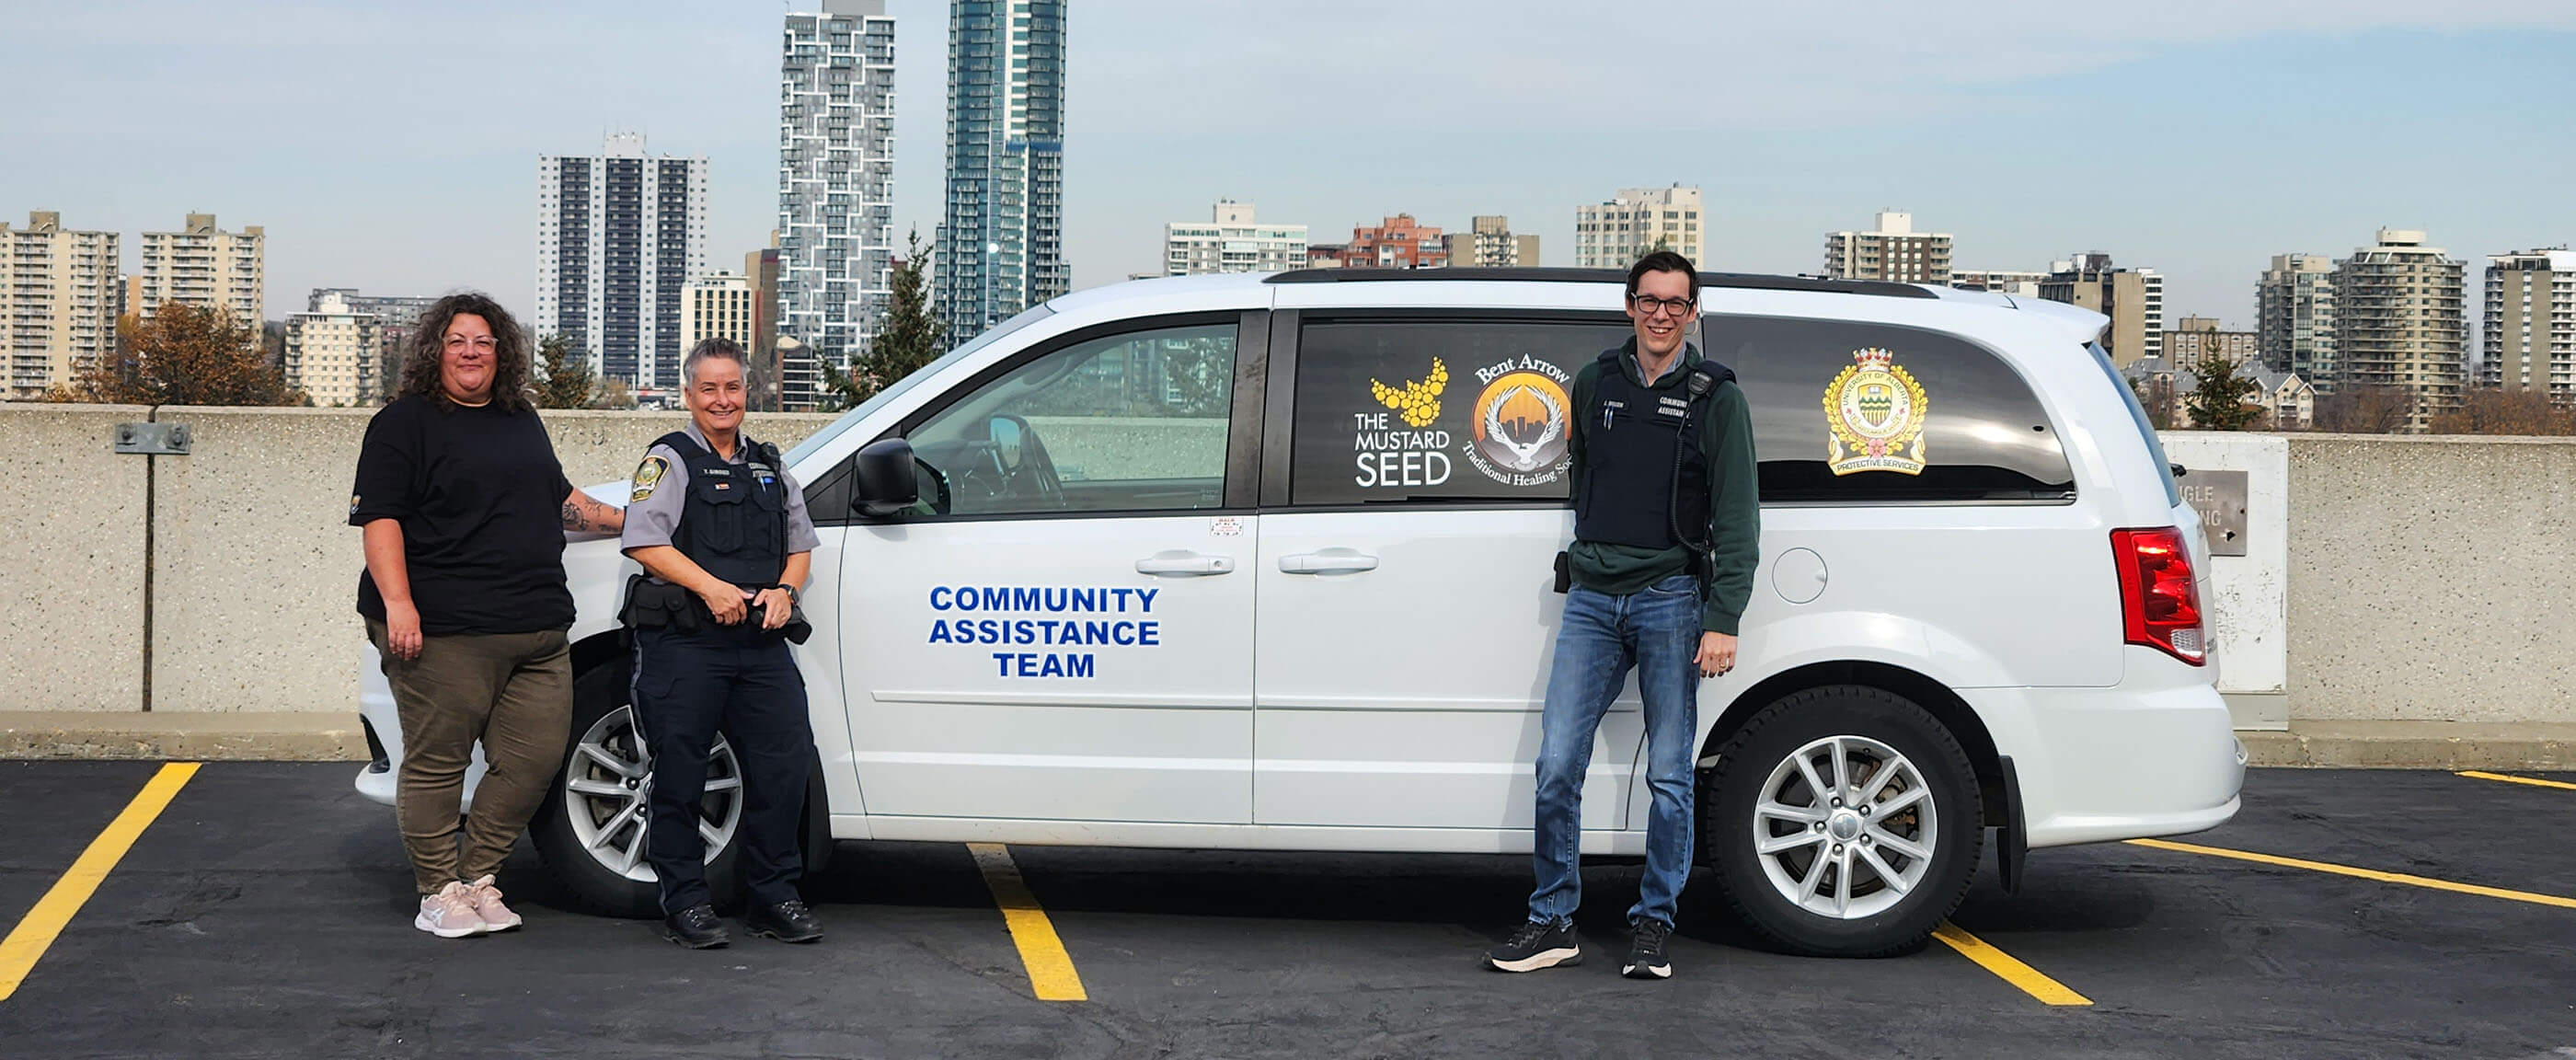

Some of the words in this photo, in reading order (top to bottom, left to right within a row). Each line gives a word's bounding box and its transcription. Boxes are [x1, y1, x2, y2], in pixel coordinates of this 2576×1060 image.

[1475, 357, 1515, 386] Bent
[1518, 353, 1570, 385] Arrow
[1843, 373, 1872, 406] UNIVERSITY
[1886, 375, 1909, 405] ALBERTA
[1354, 413, 1388, 430] THE
[1355, 431, 1450, 451] MUSTARD
[1355, 452, 1452, 487] SEED
[1462, 441, 1512, 485] Traditional
[1513, 470, 1557, 487] Healing
[1555, 453, 1573, 475] Soc
[1836, 459, 1882, 471] PROTECTIVE
[1882, 459, 1919, 471] SERVICES
[929, 586, 1159, 612] COMMUNITY
[928, 619, 1159, 646] ASSISTANCE
[993, 653, 1094, 677] TEAM
